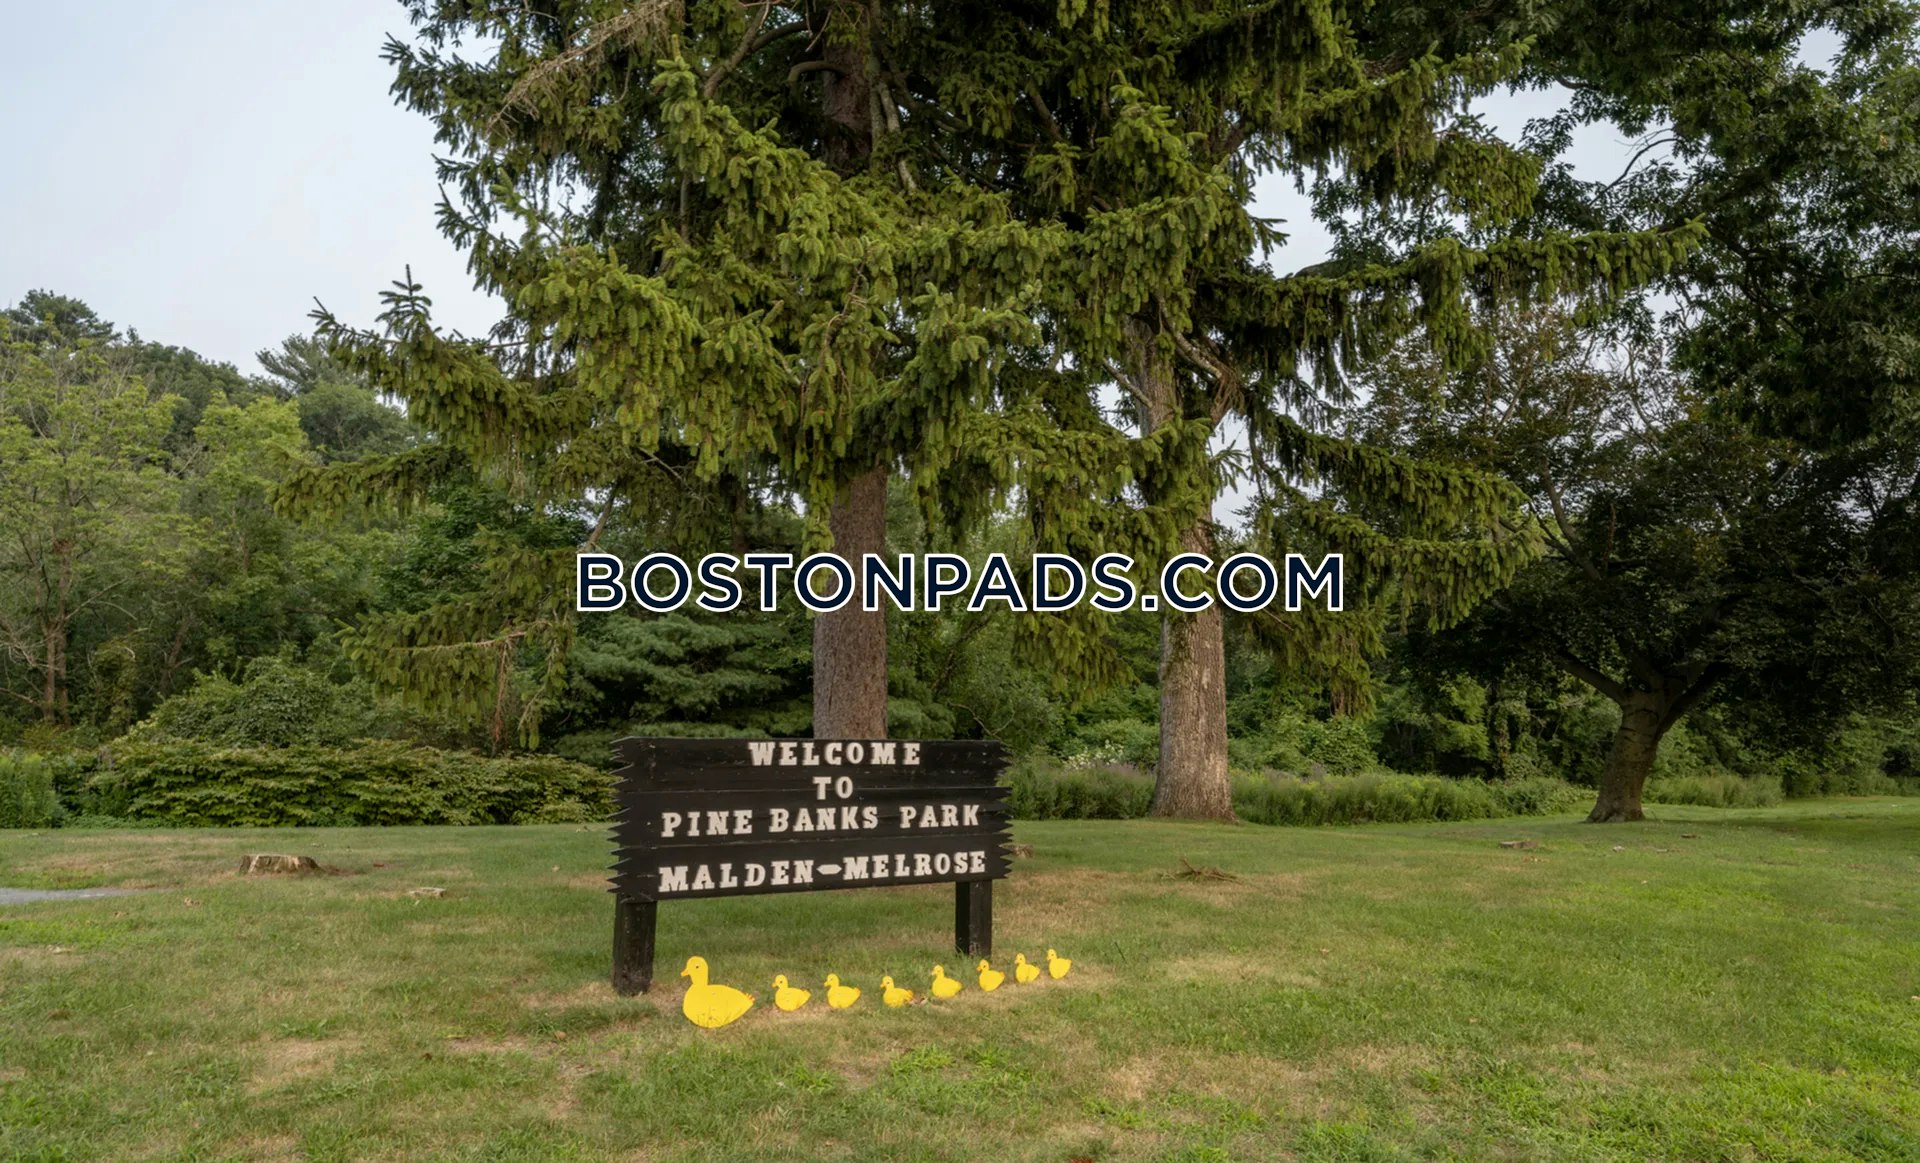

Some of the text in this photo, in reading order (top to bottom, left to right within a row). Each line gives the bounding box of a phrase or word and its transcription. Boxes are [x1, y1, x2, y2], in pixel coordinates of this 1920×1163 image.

[748, 741, 921, 766] WELCOME
[812, 775, 854, 800] TO
[660, 804, 981, 838] PINE BANKS PARK
